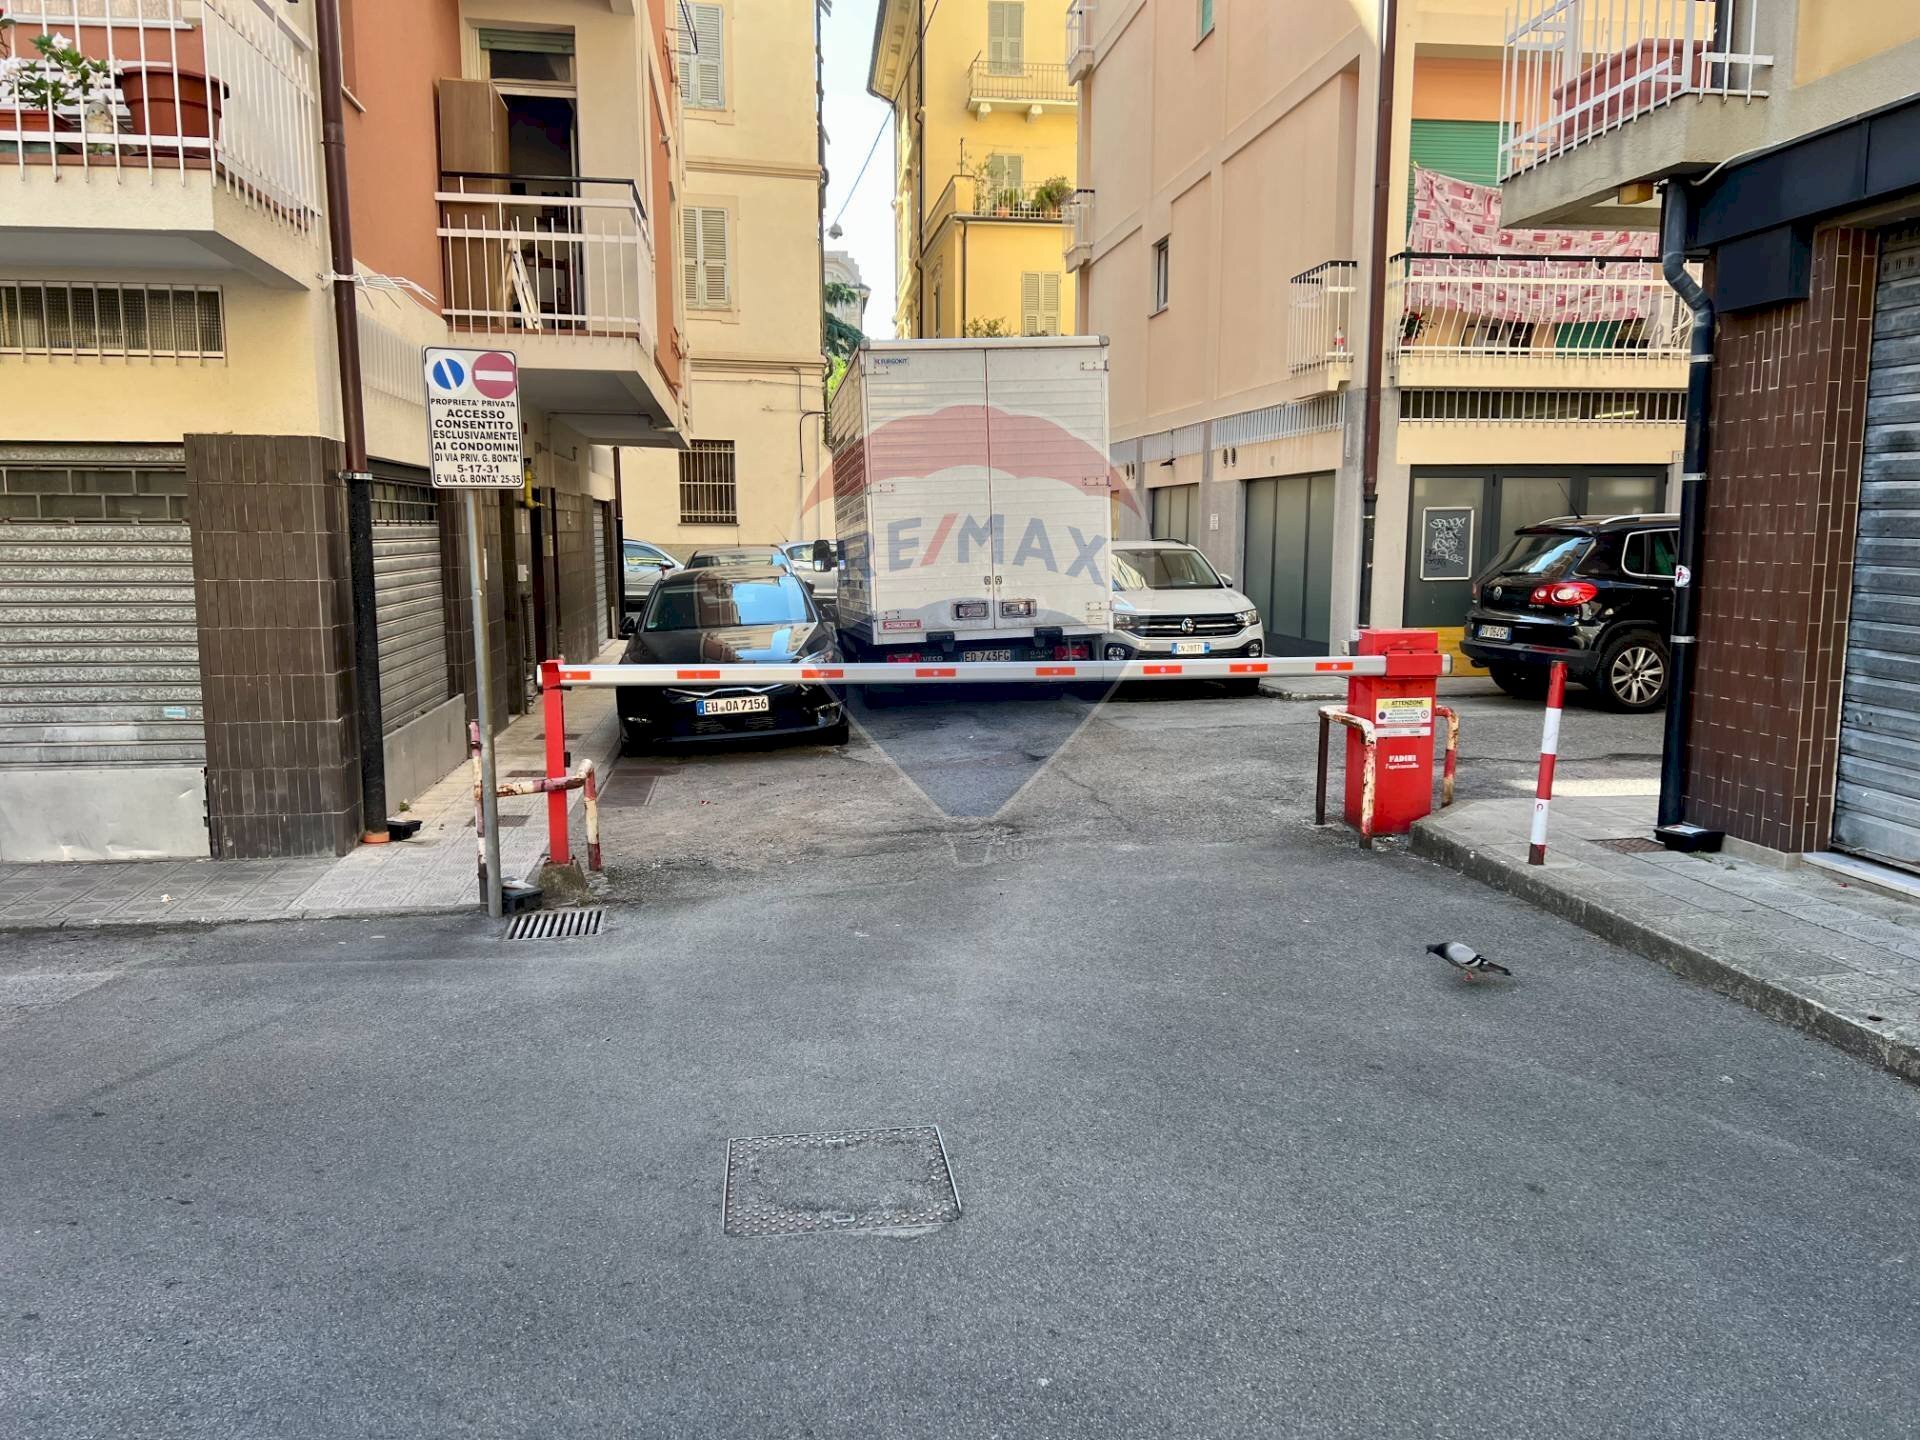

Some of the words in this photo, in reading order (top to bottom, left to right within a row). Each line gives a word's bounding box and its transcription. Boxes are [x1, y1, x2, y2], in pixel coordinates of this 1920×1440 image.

[430, 398, 479, 407] PROPRIETA'
[481, 400, 516, 408] PRIVATA
[446, 409, 505, 419] ACCESSO
[435, 420, 513, 430] CONSENTITO
[433, 431, 518, 441] ESCLUSIVAMENTE
[434, 442, 446, 450] AI
[450, 442, 519, 452] CONDOMINI
[435, 453, 443, 462] DI
[446, 453, 458, 462] VIA
[460, 454, 480, 462] PRIV.
[482, 454, 490, 463] G.
[492, 454, 520, 463] BONTA'
[457, 464, 500, 473] 5-17-31
[436, 474, 442, 483] E
[444, 474, 457, 483] VIA
[459, 474, 468, 483] G.
[470, 475, 498, 483] BONTA'
[501, 475, 521, 484] 25-35
[741, 698, 767, 710] 7156
